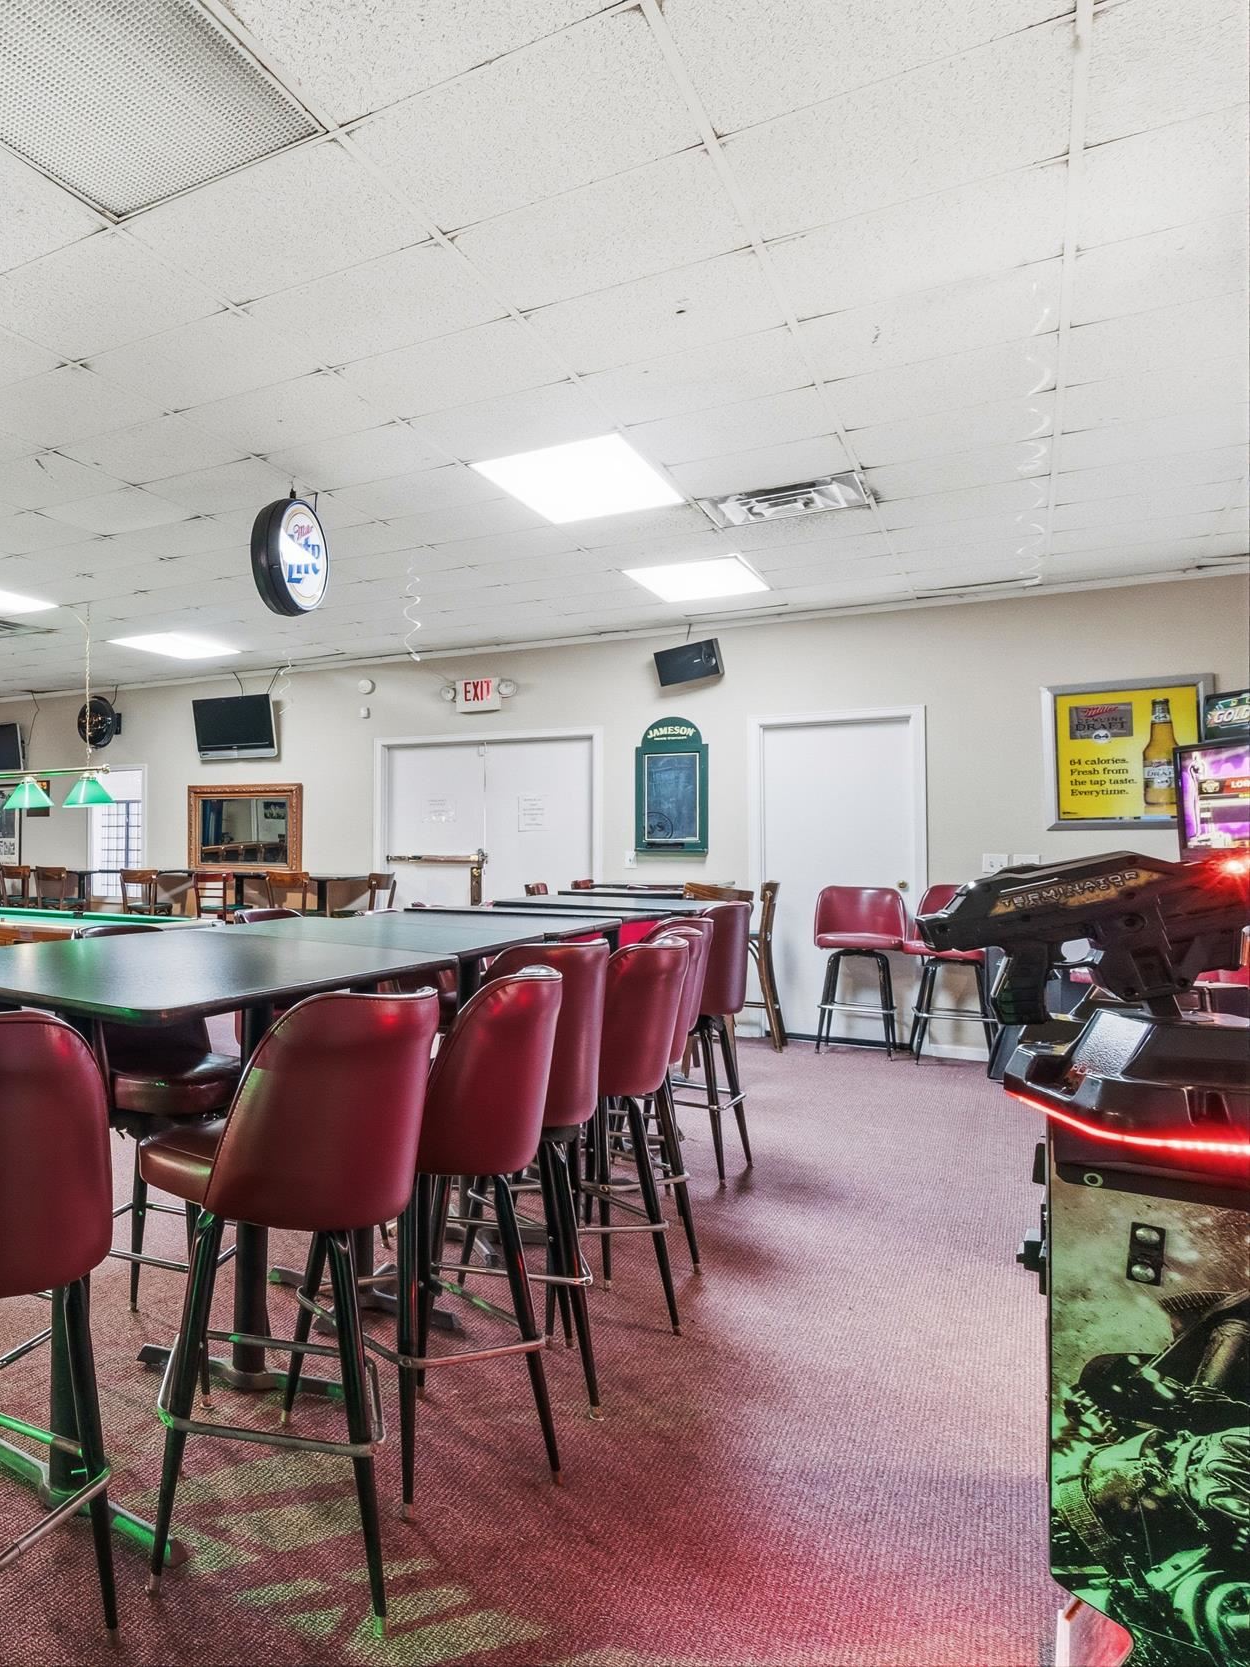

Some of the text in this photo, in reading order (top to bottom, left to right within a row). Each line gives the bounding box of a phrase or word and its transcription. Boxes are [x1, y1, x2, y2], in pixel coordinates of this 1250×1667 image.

[463, 680, 492, 701] EXIT
[1075, 721, 1126, 731] DRAFT
[646, 726, 695, 738] JAMESON
[1084, 757, 1129, 766] calories.
[1070, 767, 1129, 776] Fresh from
[1090, 779, 1106, 787] tap
[1109, 777, 1137, 785] taste.
[1070, 788, 1129, 797] Everytime.
[1001, 871, 1138, 907] TERMINATOR
